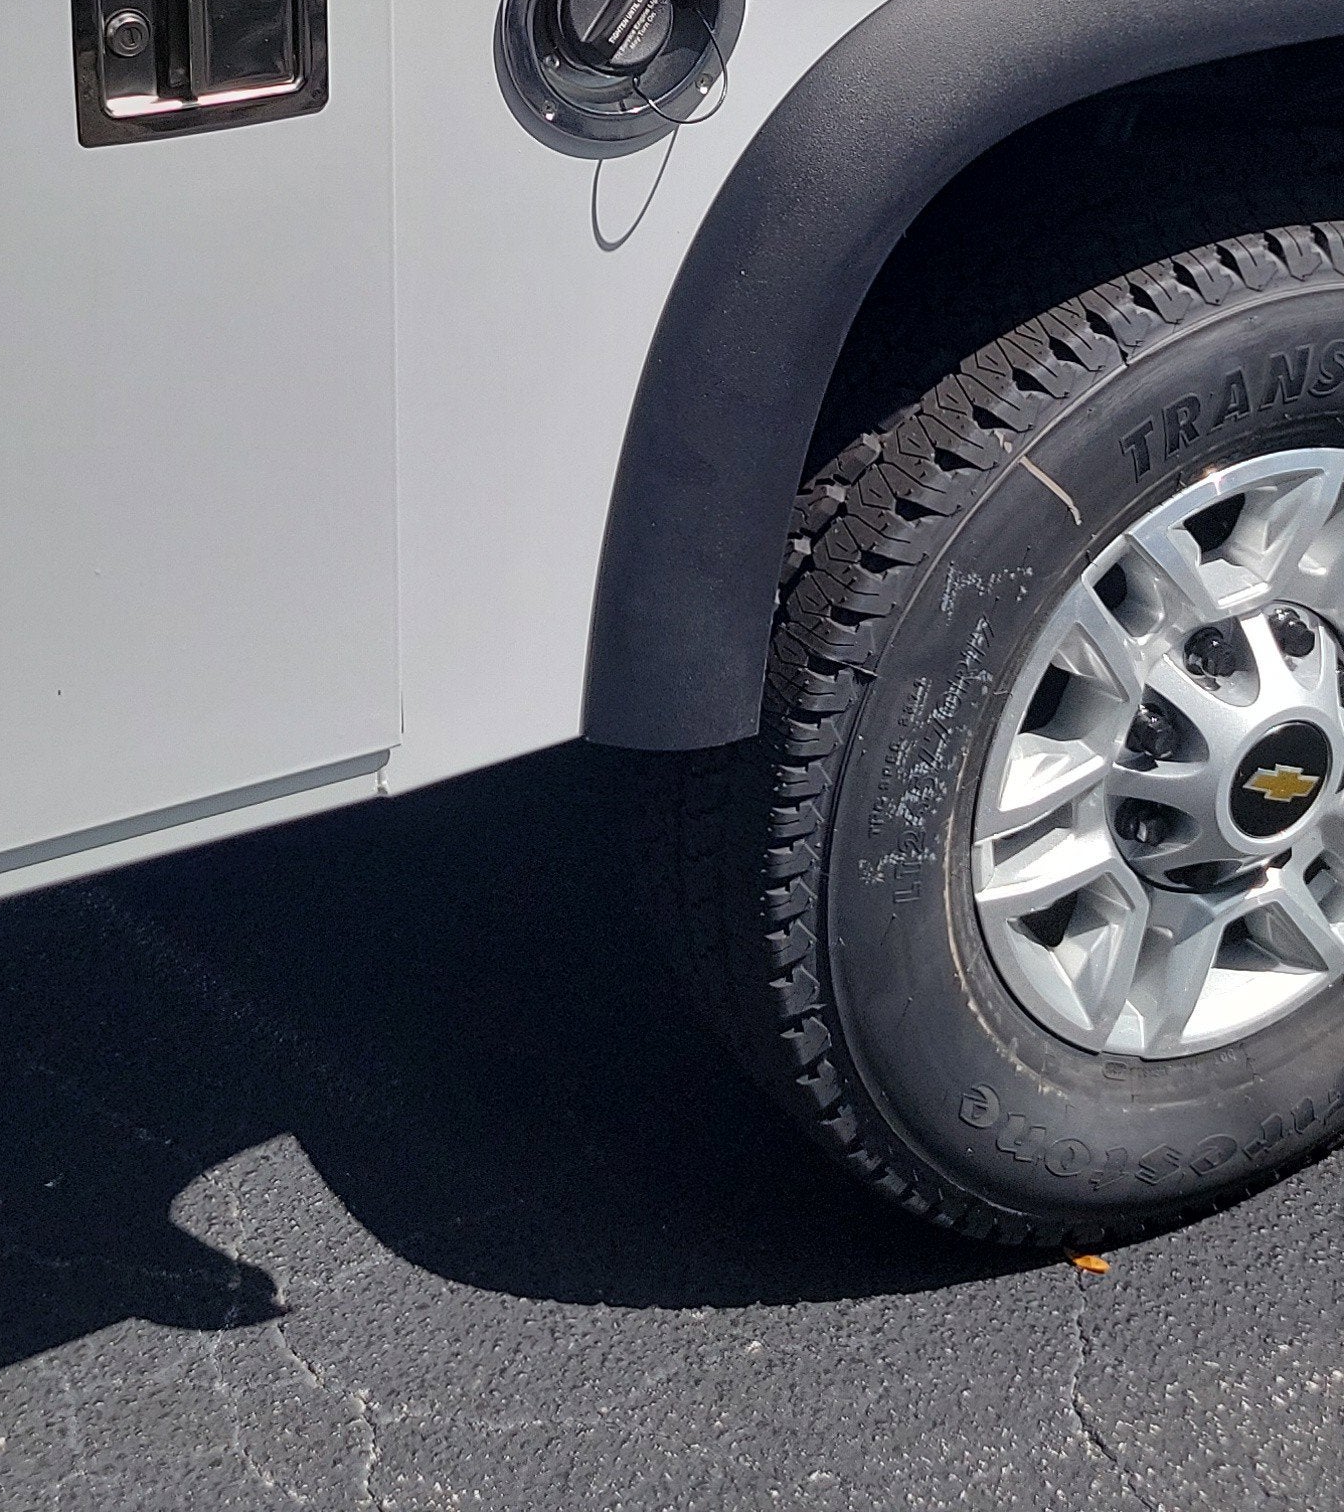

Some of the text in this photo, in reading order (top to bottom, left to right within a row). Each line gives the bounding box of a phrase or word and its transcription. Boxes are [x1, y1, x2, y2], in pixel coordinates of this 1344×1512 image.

[608, 17, 629, 44] TIGHTEN
[625, 2, 640, 20] UNTIL
[634, 8, 650, 30] Engine
[638, 21, 651, 37] Turn
[647, 12, 657, 23] On
